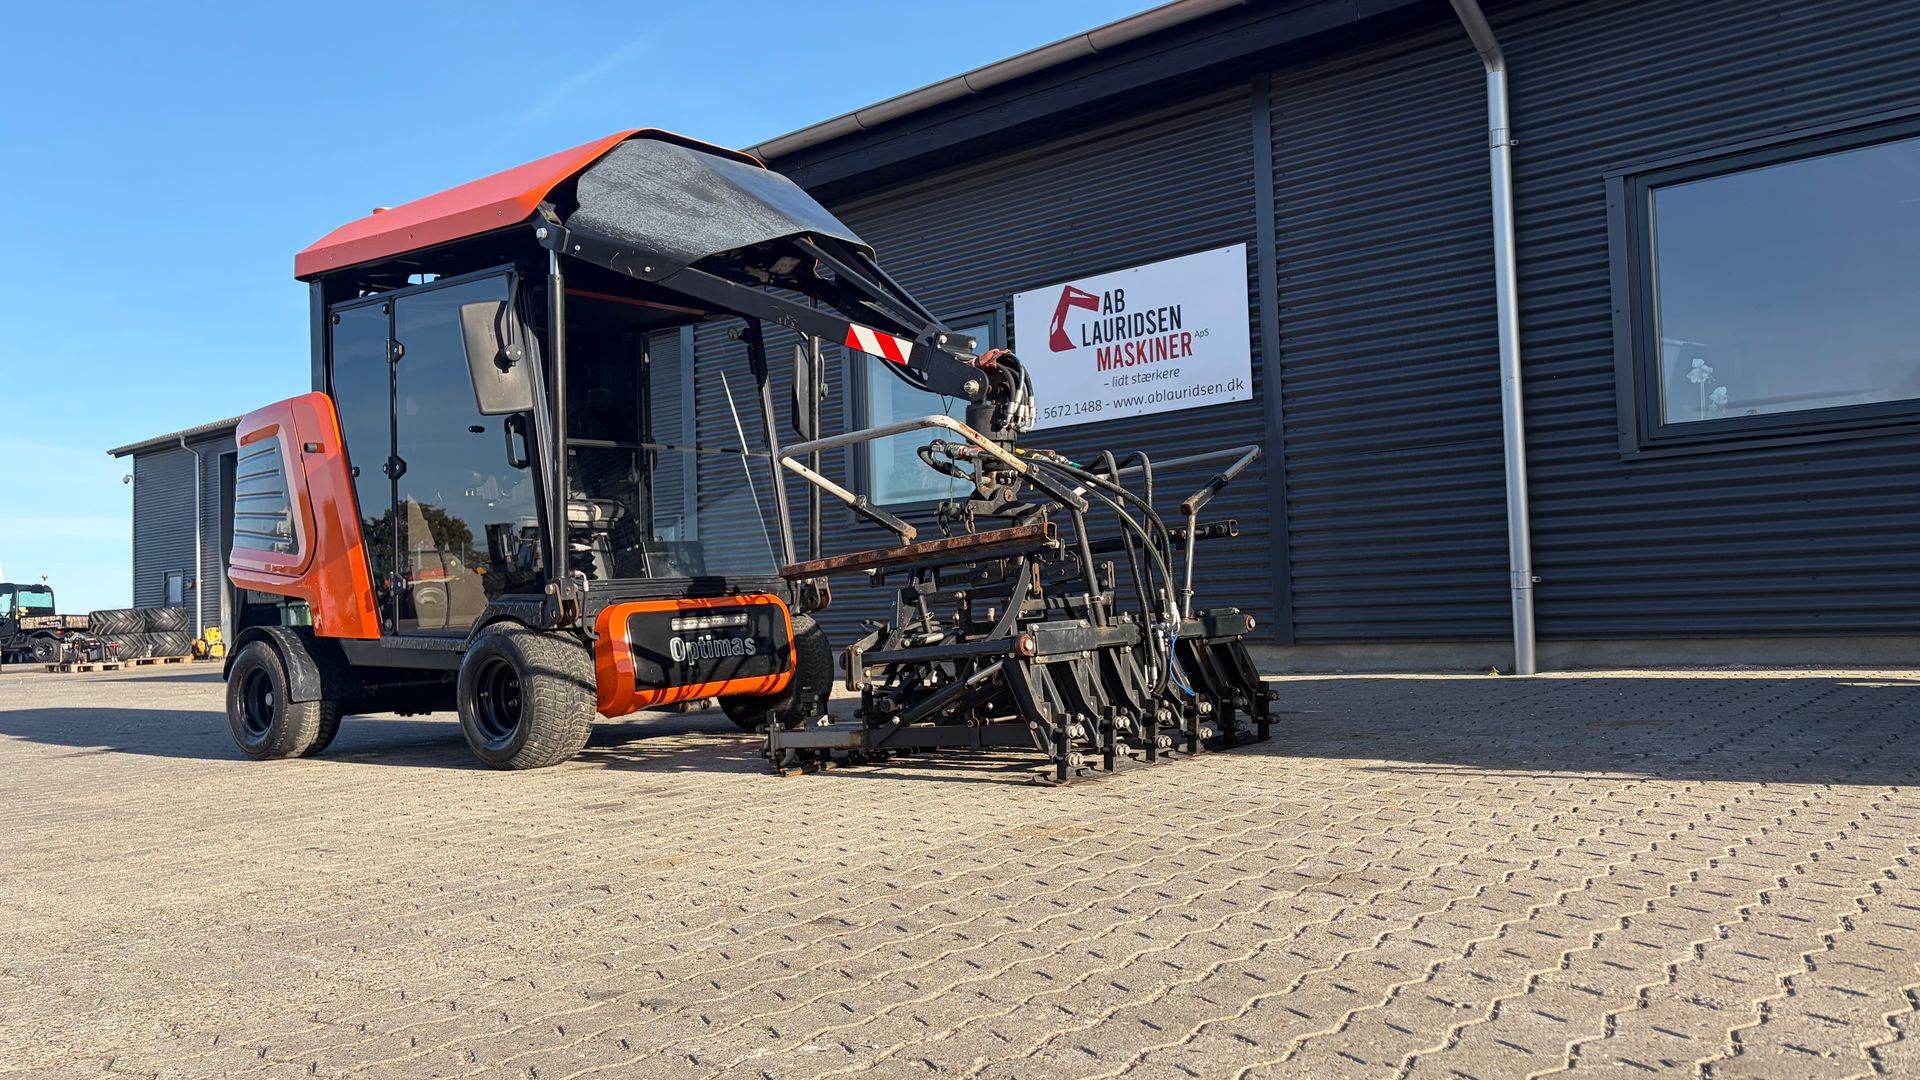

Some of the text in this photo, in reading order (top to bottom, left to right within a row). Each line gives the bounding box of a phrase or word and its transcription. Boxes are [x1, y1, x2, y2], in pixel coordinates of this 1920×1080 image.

[1102, 288, 1126, 316] AB
[1081, 304, 1182, 347] LAURIDSEN
[1096, 328, 1210, 372] MASKINER ApS
[1111, 373, 1129, 389] lidt
[1131, 367, 1181, 385] stærkere
[1044, 404, 1072, 419] 5672
[1074, 399, 1102, 415] 1488
[1113, 377, 1245, 409] www.ablauridsen.dk
[669, 634, 757, 666] Optimas
